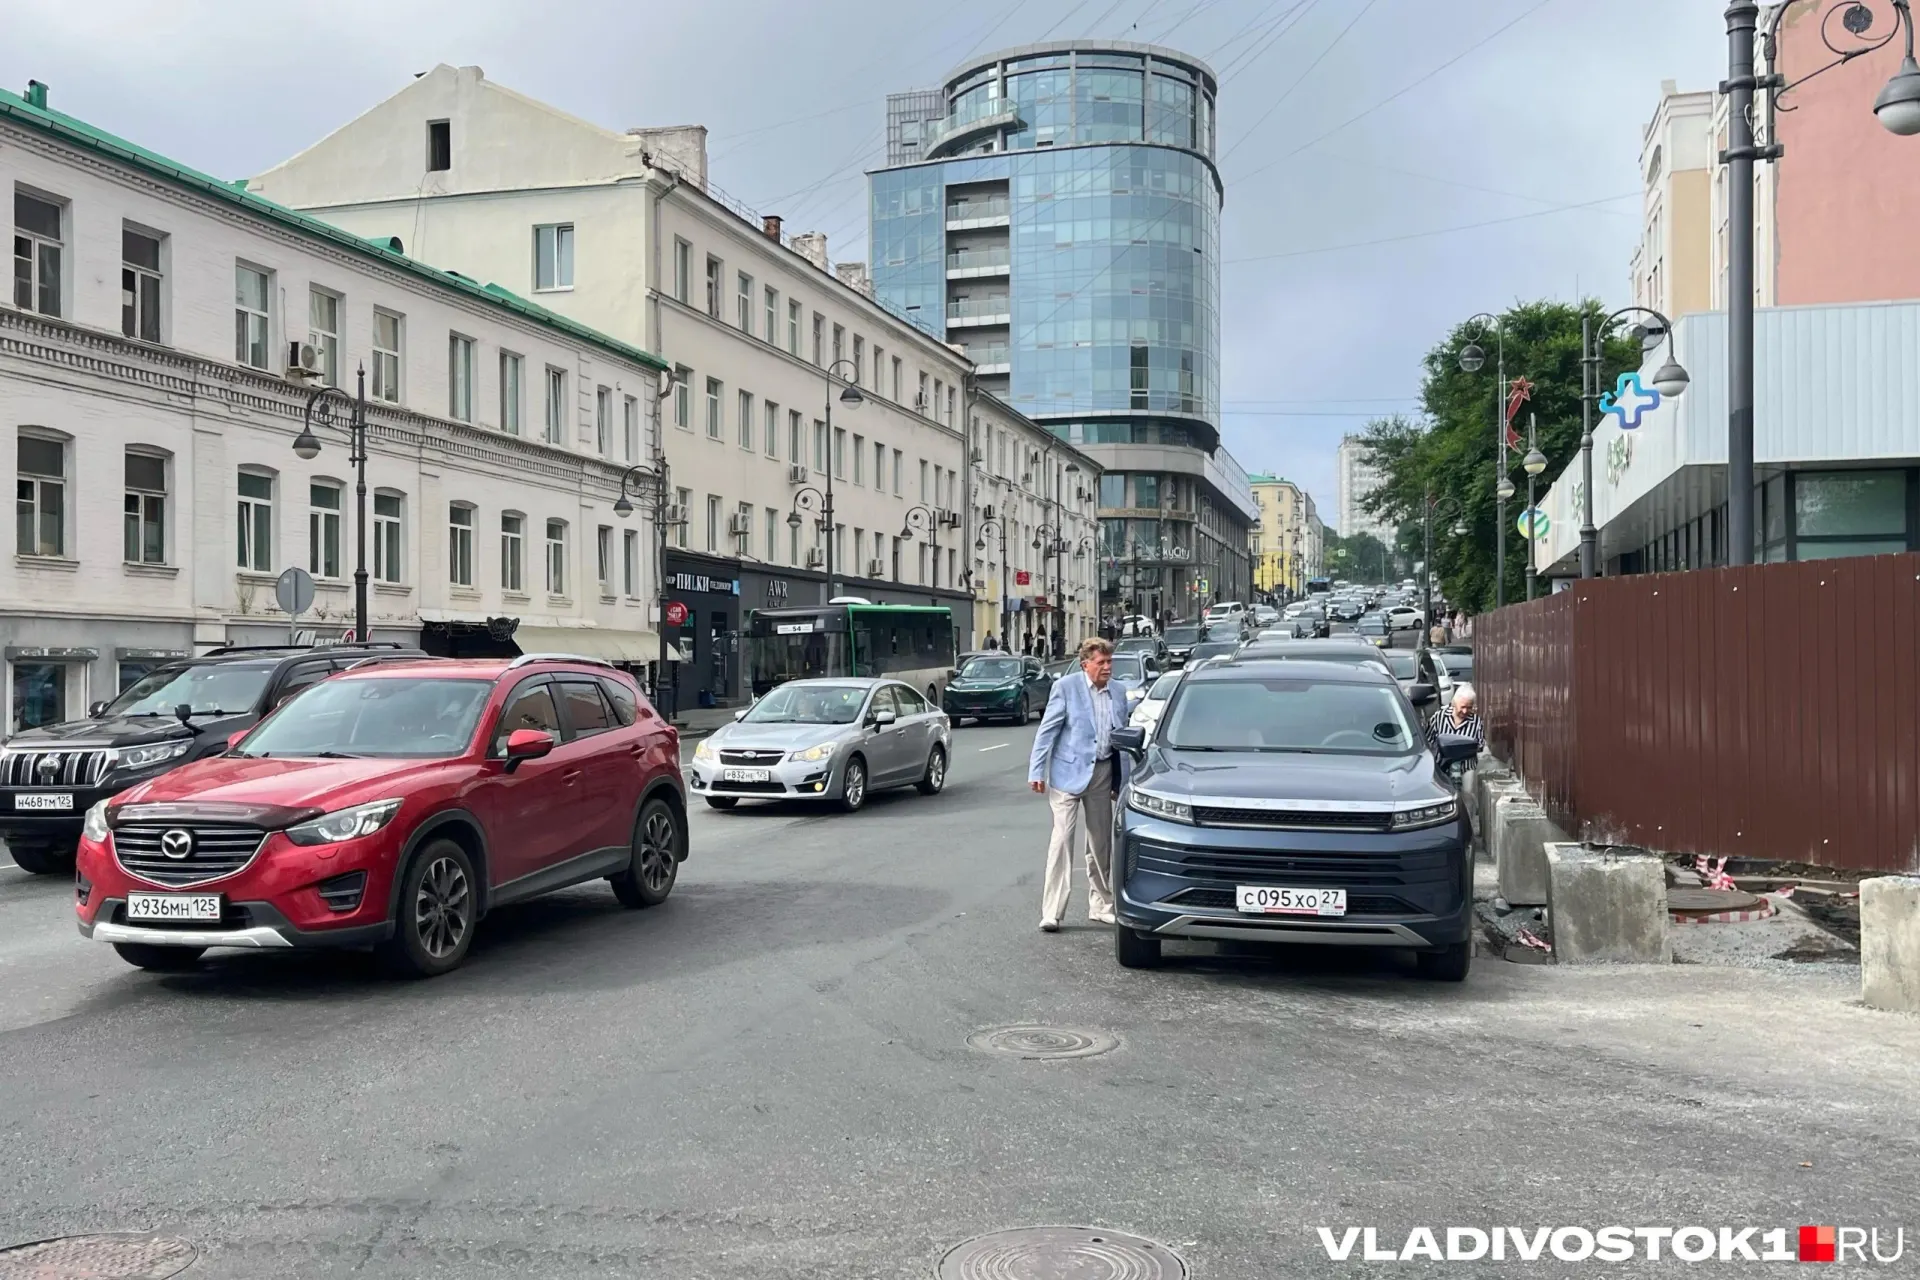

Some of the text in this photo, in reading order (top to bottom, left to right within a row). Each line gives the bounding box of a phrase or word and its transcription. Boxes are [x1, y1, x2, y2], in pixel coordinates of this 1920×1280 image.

[768, 580, 788, 598] AWR
[57, 796, 72, 805] 125
[132, 898, 217, 916] Х936МН 125
[1244, 889, 1340, 908] С095ХО 27
